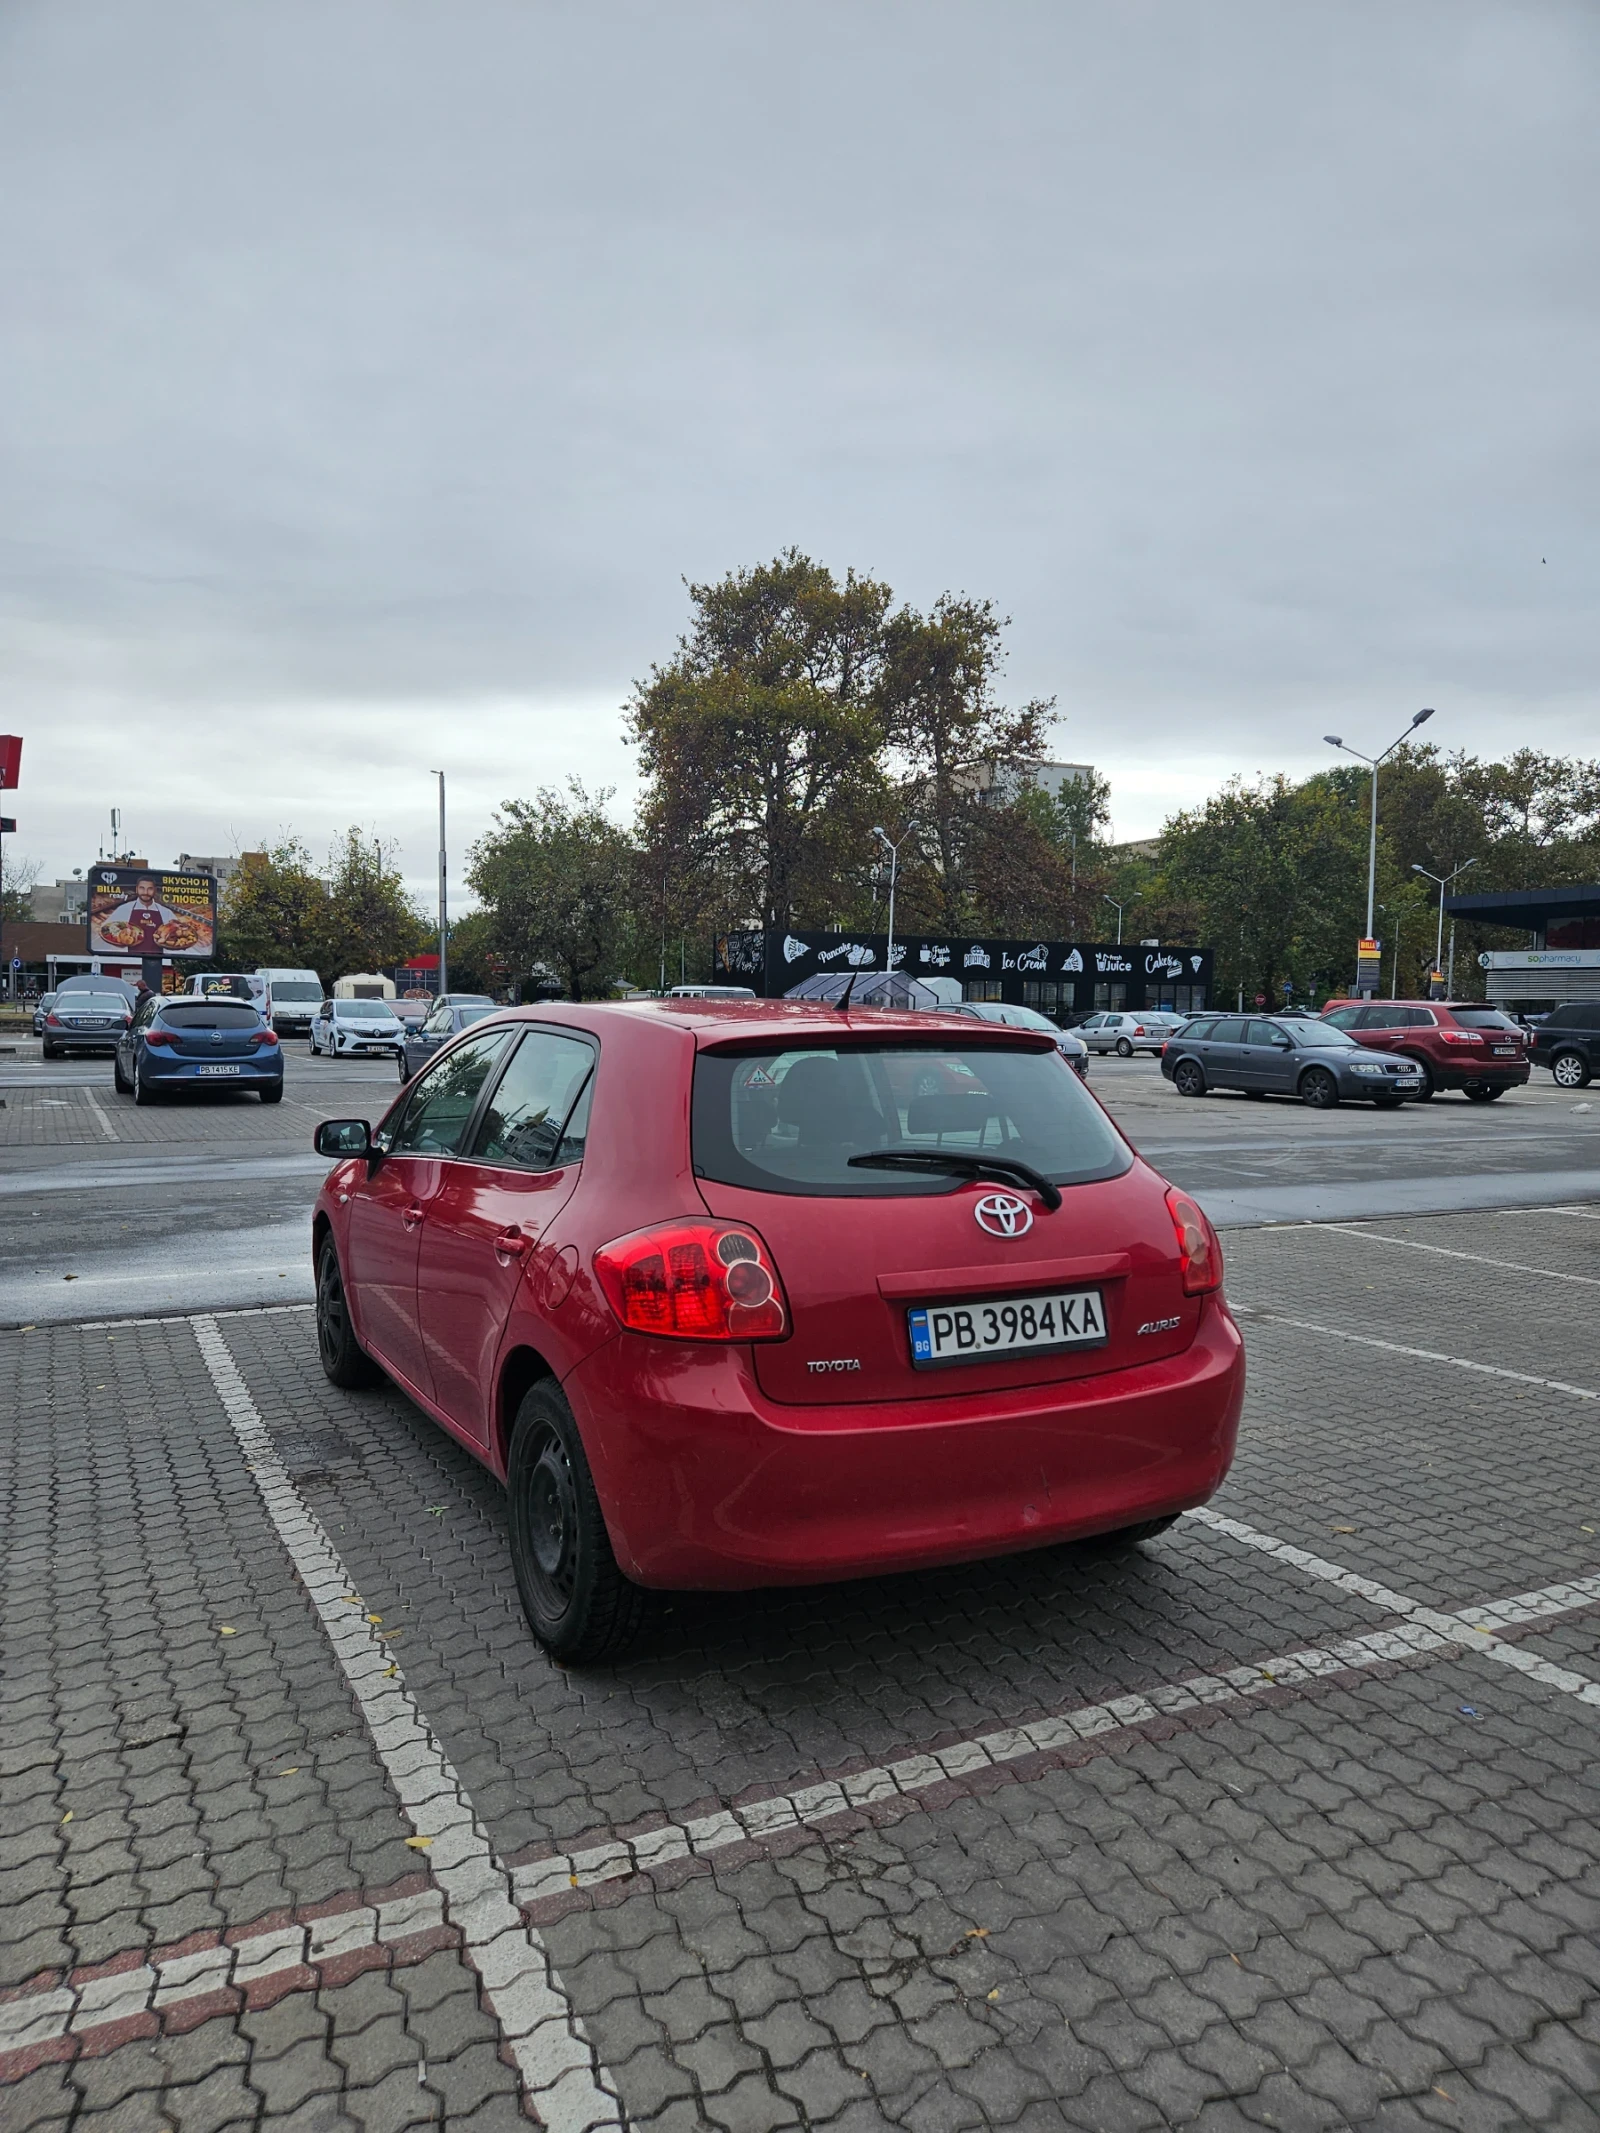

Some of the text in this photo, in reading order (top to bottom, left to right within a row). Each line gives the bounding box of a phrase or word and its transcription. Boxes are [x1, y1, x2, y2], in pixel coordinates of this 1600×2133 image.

[162, 876, 209, 887] ВКУСНО И
[97, 885, 121, 893] BILLA
[162, 886, 209, 895] ПРИГОТВЕНО
[109, 891, 128, 901] ready
[162, 894, 170, 903] С
[817, 942, 851, 964] Pancake
[1001, 952, 1047, 972] Ice Cream
[1527, 954, 1581, 965] sopharmacy
[1106, 960, 1132, 971] Juice
[1137, 1316, 1181, 1336] AURIS
[915, 1340, 930, 1353] BG
[807, 1359, 861, 1373] TOYOTA
